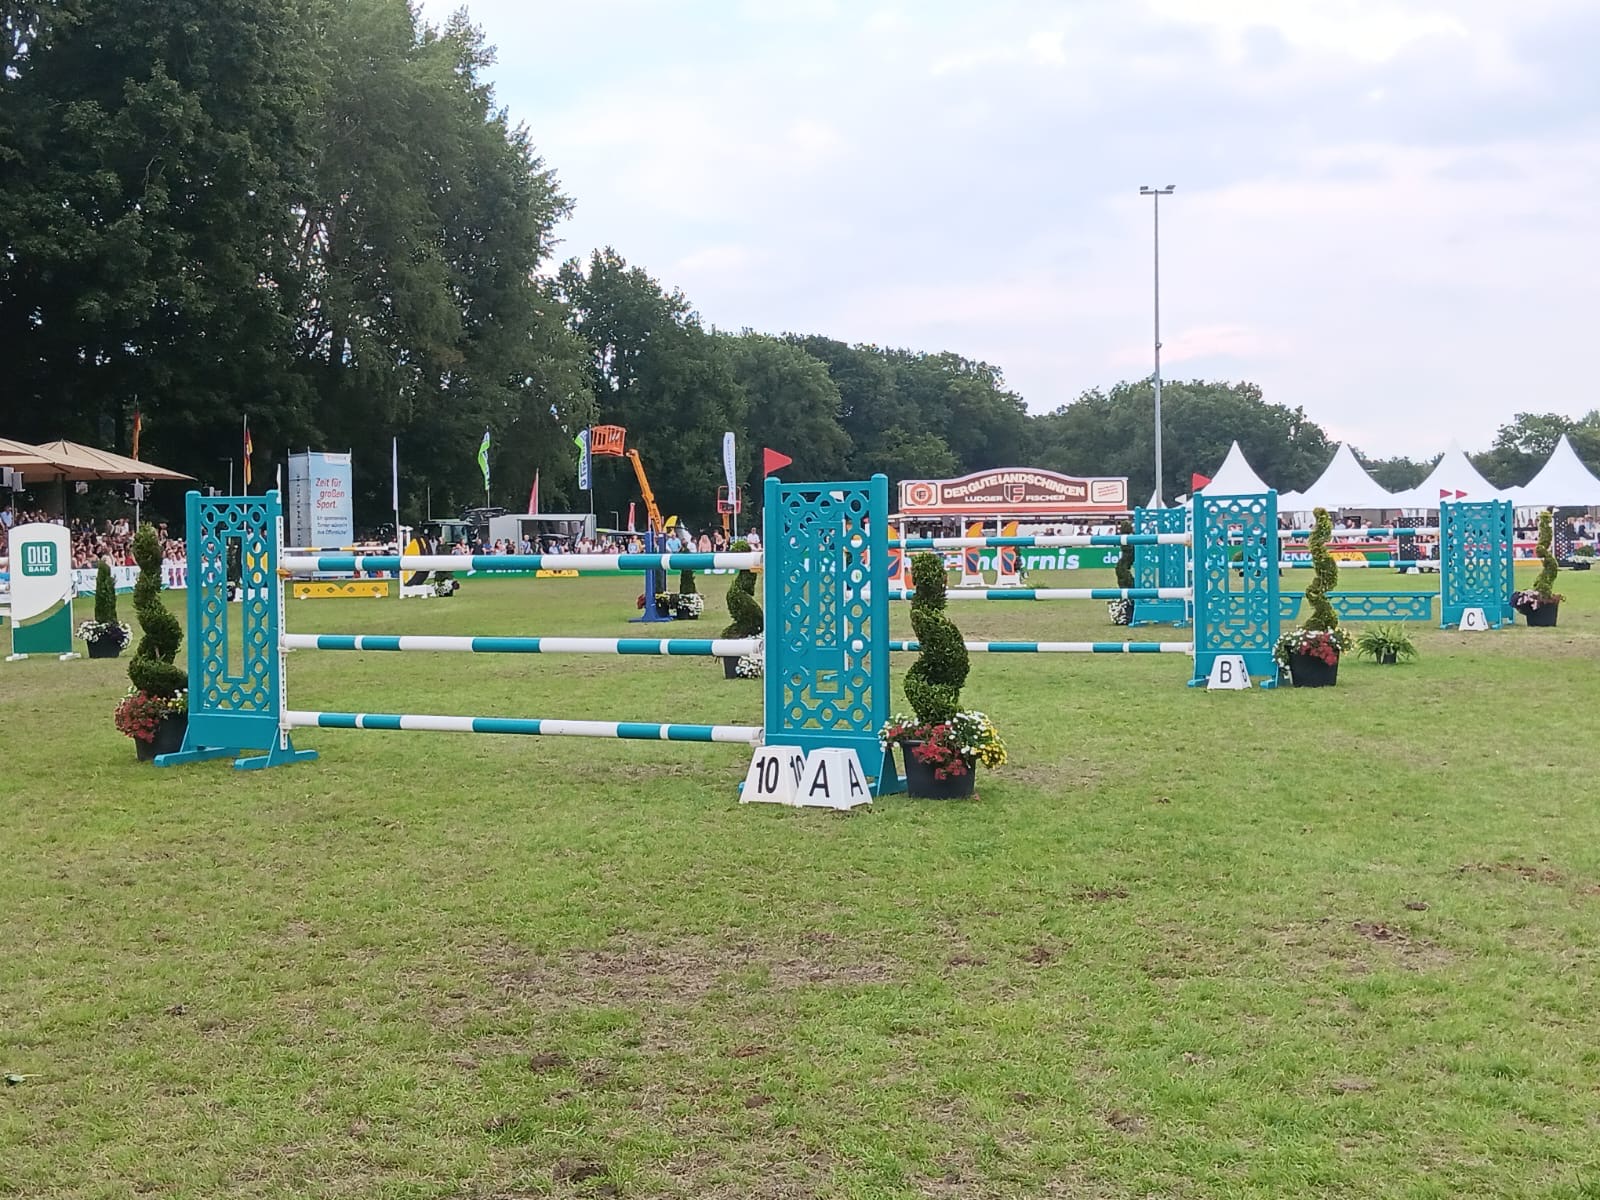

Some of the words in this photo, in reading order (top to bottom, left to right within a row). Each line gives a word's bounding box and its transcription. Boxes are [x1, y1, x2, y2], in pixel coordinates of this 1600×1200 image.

[315, 477, 329, 487] Zeit
[331, 477, 342, 487] für
[944, 486, 970, 499] DER
[968, 475, 999, 493] GUTE
[998, 473, 1085, 497] LANDSCHINKEN
[320, 489, 345, 500] großen
[1026, 494, 1066, 502] FISCHER
[27, 546, 51, 564] OLB
[1466, 612, 1475, 626] C
[1220, 660, 1232, 683] B
[756, 756, 779, 794] 10
[809, 759, 830, 798] A
[848, 758, 864, 797] A
